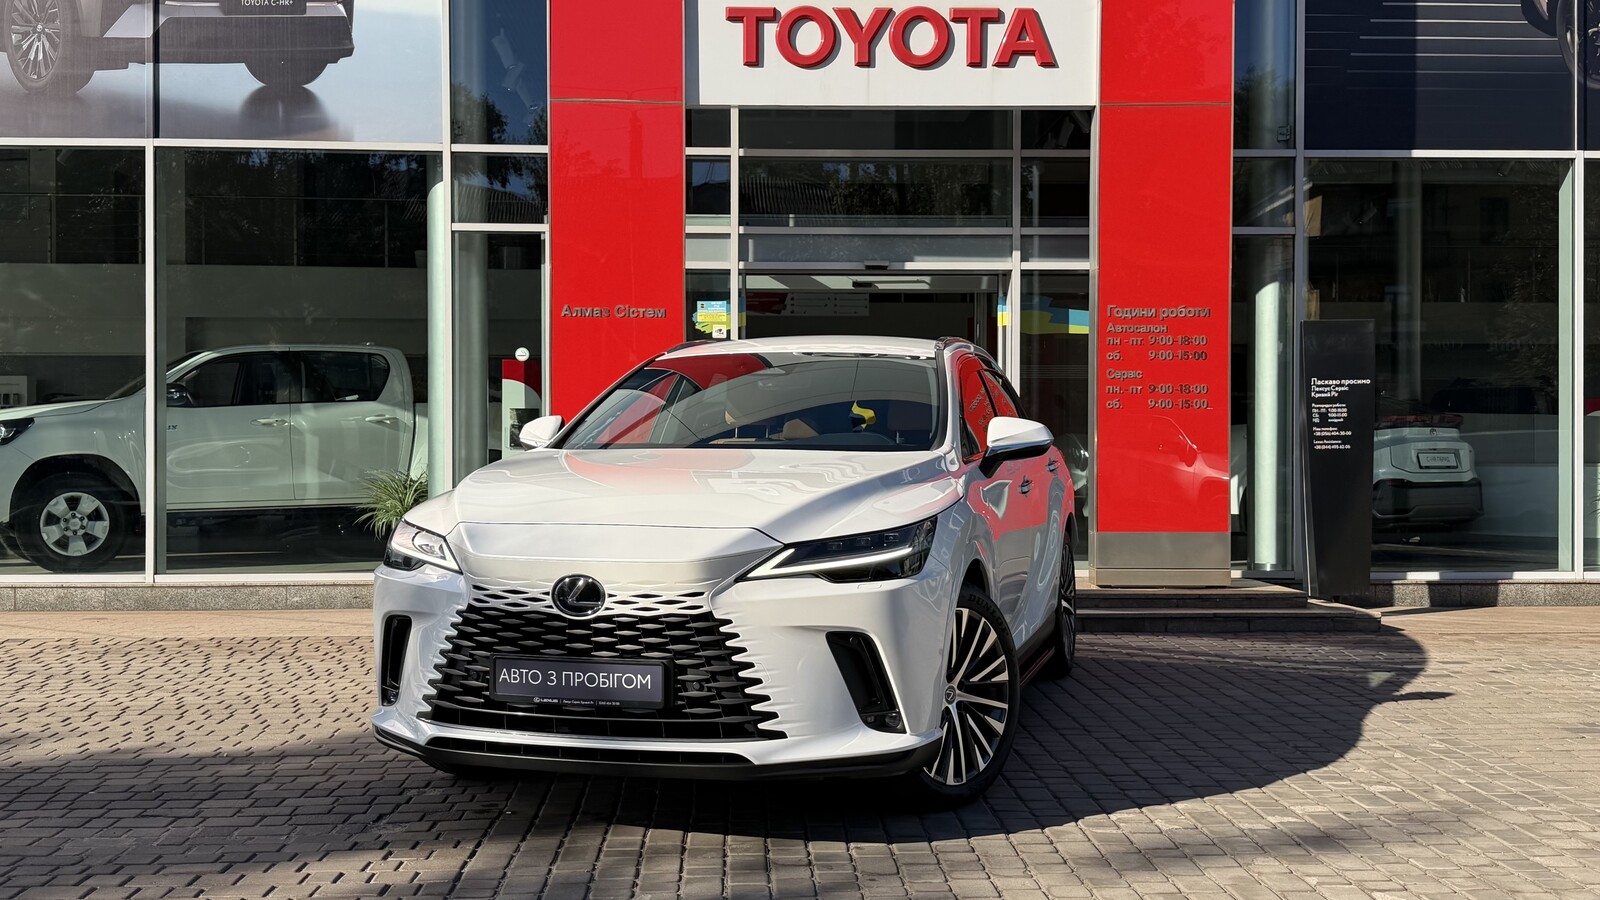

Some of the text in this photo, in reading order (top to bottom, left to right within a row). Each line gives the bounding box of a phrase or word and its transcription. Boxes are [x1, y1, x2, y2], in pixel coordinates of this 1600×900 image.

[725, 5, 1056, 68] TOYOTA
[561, 304, 666, 318] Алмаз Сістем
[1107, 304, 1211, 321] Години роботи
[1106, 322, 1168, 334] Автосалон
[1148, 335, 1208, 346] 9:00-18:00
[1106, 350, 1208, 360] сб. 9:00-15:00
[1106, 368, 1144, 380] Сервіс
[1148, 384, 1208, 394] 9:00-18:00
[1106, 398, 1208, 410] сб. 9:00-15:00
[968, 594, 1010, 636] DUNLOP
[499, 668, 542, 684] АВТО
[562, 671, 651, 690] ПРОБІГОМ
